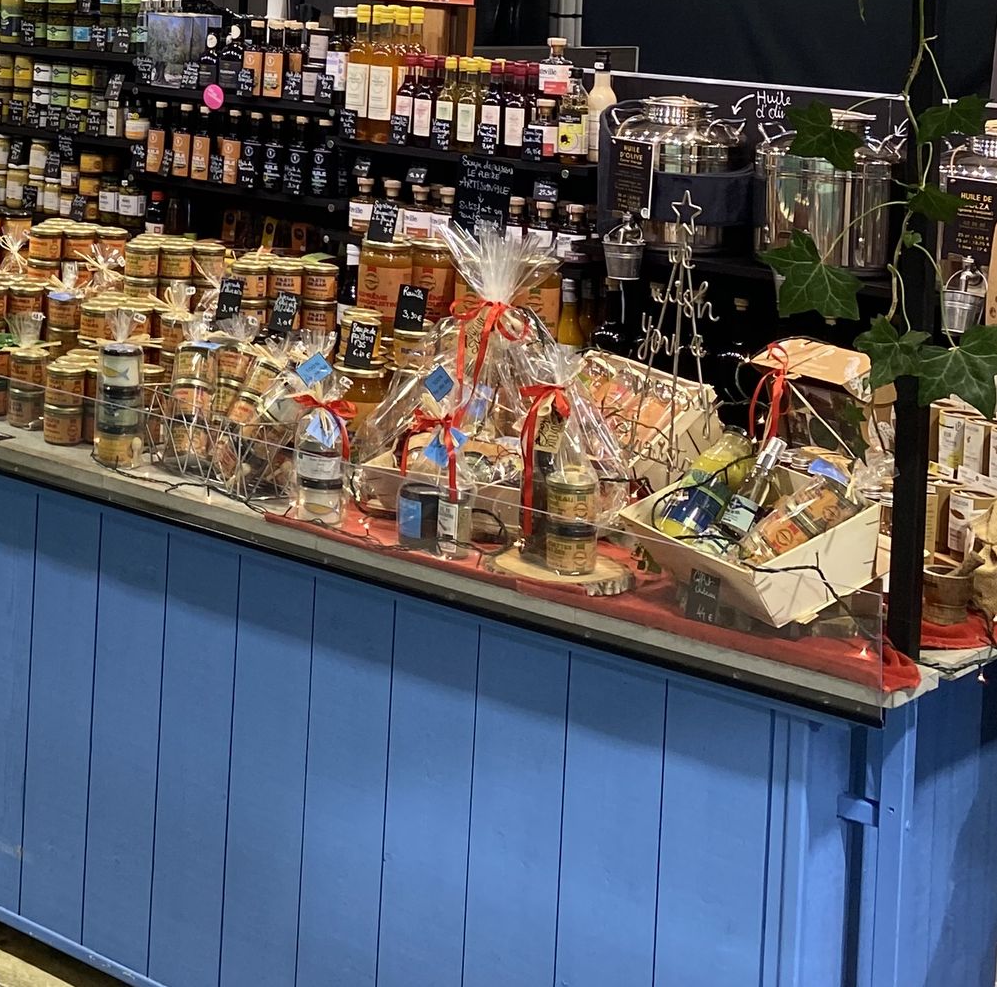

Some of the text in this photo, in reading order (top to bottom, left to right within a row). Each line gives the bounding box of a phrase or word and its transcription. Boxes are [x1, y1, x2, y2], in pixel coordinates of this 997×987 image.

[757, 91, 792, 107] Huile
[619, 151, 643, 161] D'OLIVE
[961, 192, 993, 203] HUILE DE
[650, 280, 720, 322] wish
